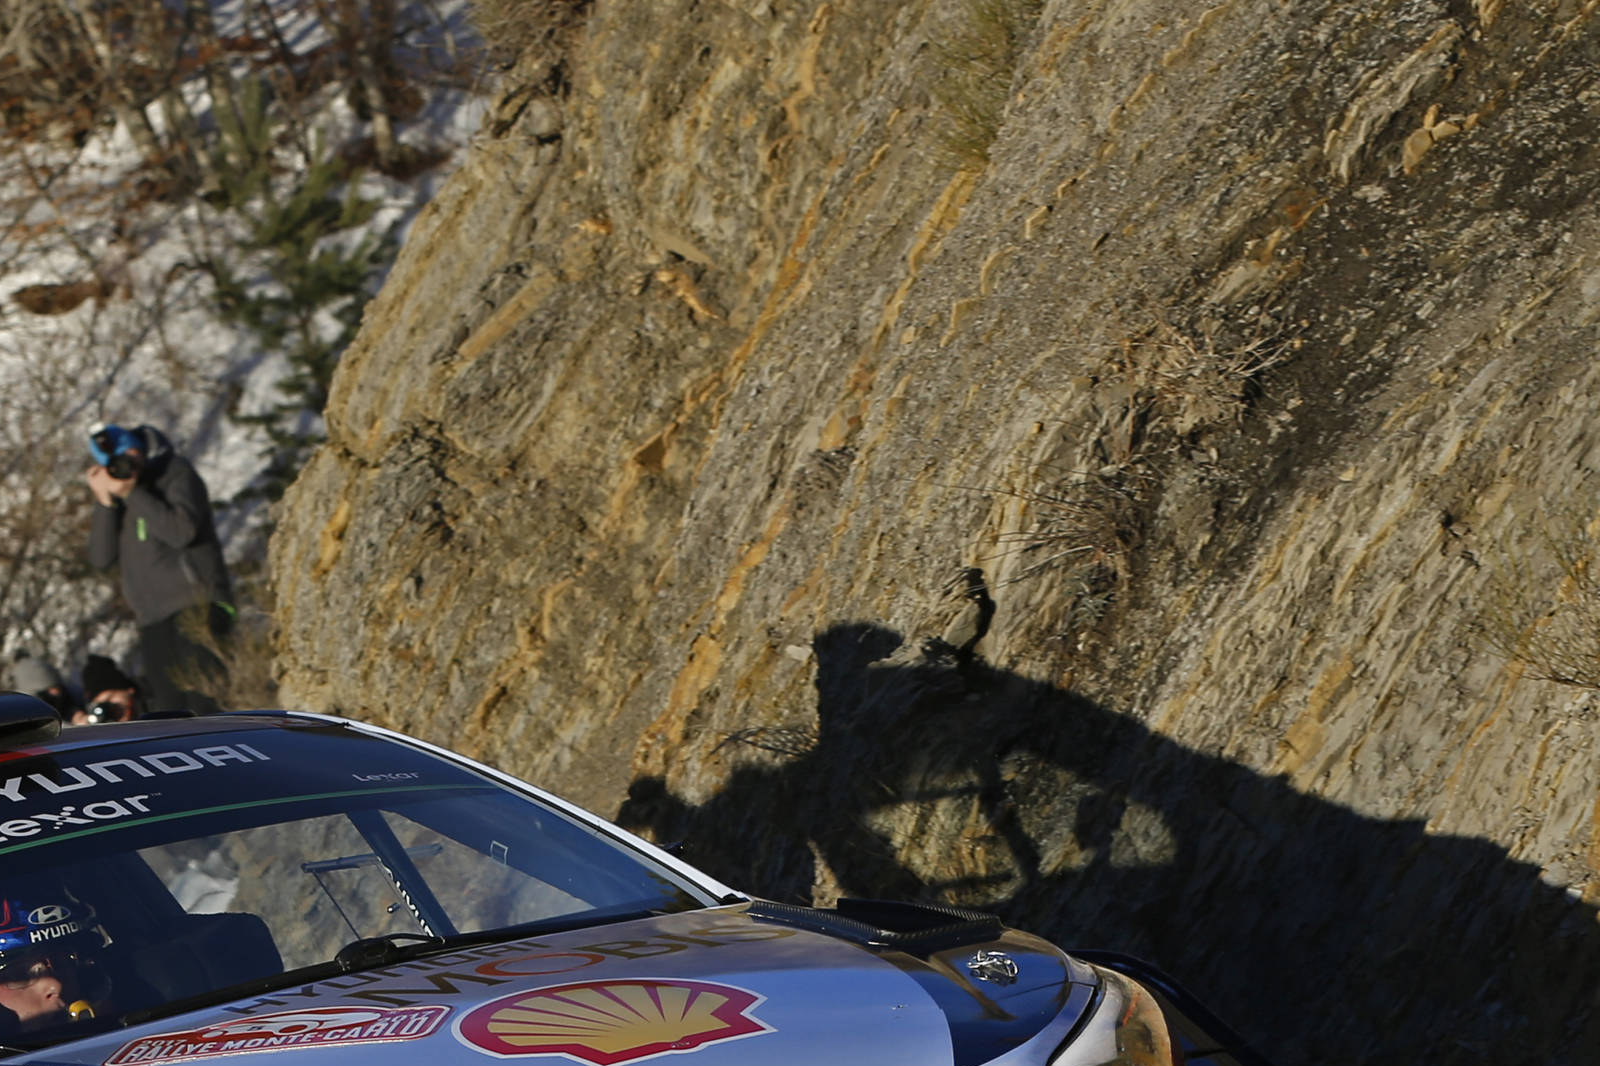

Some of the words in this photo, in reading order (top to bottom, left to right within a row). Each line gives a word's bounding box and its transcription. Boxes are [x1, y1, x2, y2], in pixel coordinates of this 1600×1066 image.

[343, 923, 798, 1006] MOBIS
[119, 1041, 215, 1063] RALLYE
[221, 1014, 431, 1051] MONTE-CARLO
